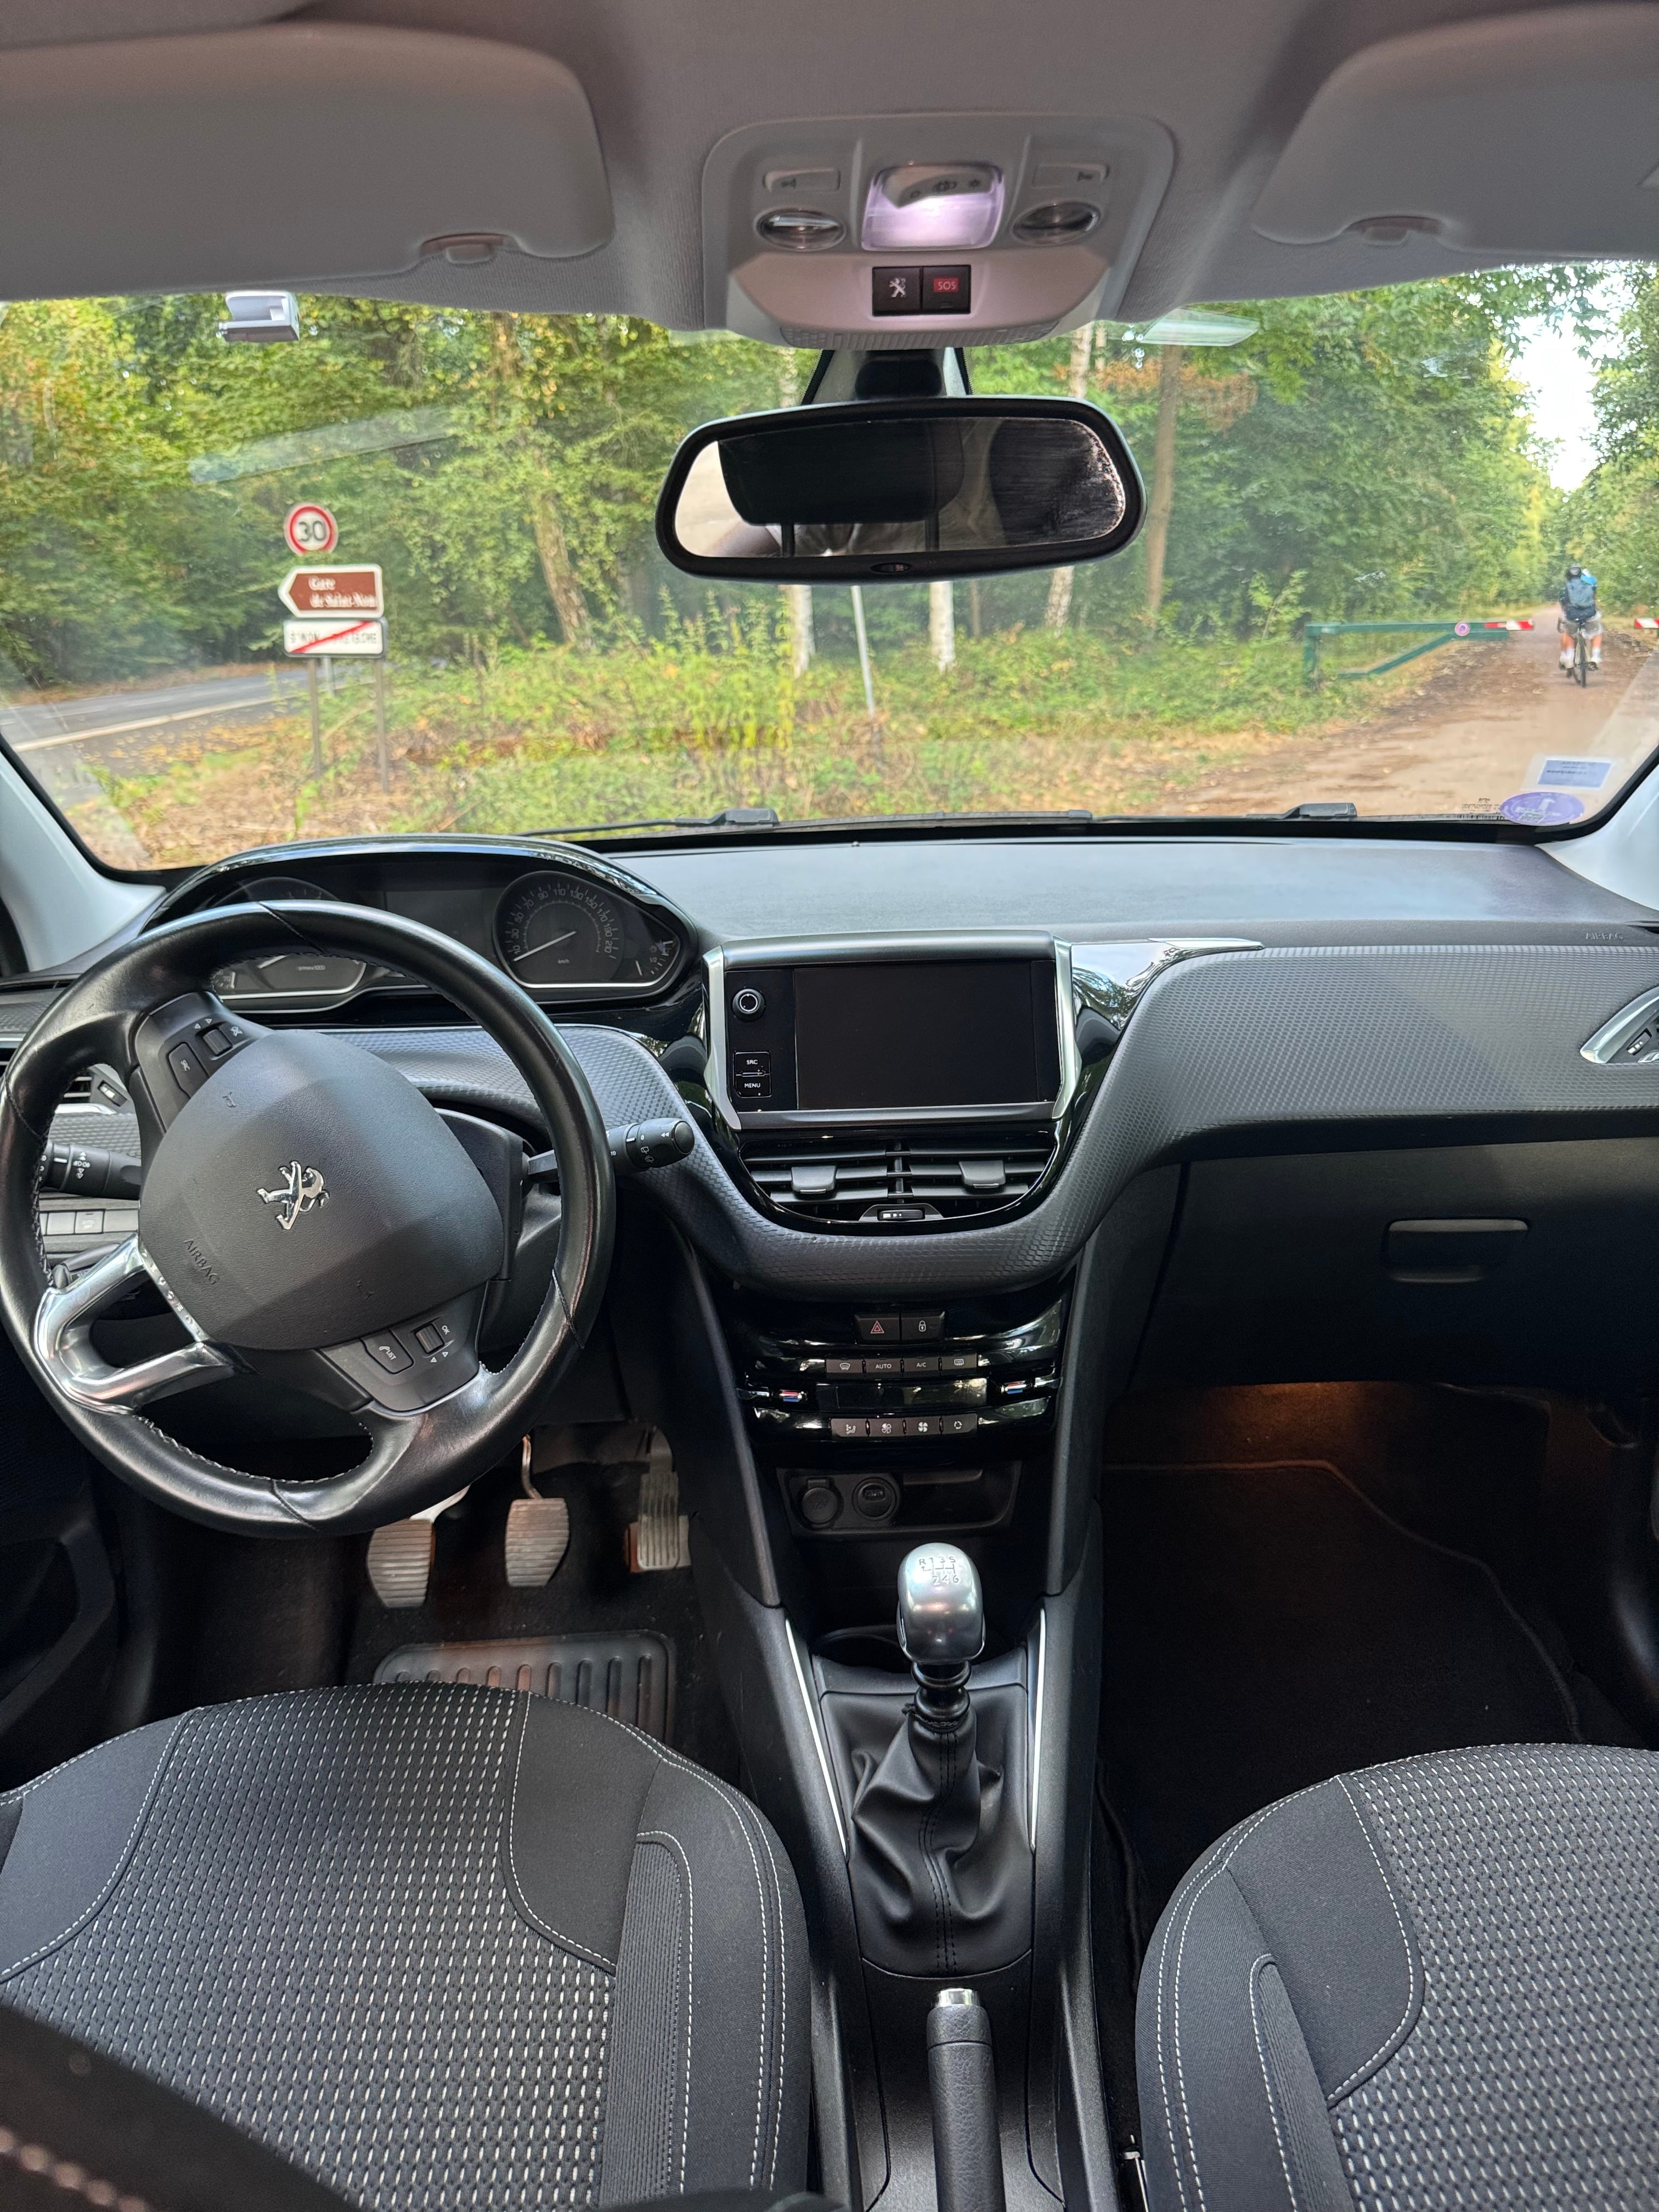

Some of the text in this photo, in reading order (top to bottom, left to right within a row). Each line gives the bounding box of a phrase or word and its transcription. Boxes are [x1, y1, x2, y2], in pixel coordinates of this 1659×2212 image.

[938, 281, 956, 290] SOS
[298, 521, 327, 541] 30
[308, 575, 336, 590] Gare
[538, 891, 549, 900] 90
[570, 890, 584, 900] 130
[524, 900, 534, 909] 70
[585, 897, 598, 909] 150
[515, 912, 524, 922] 50
[597, 909, 608, 922] 170
[511, 929, 520, 939] 30
[604, 923, 613, 937] 190
[513, 945, 521, 954] 10
[604, 940, 613, 953] 210
[180, 1059, 190, 1071] SRC
[183, 1239, 220, 1285] AIRBAG
[441, 1325, 450, 1335] OK
[386, 1350, 397, 1361] LIST
[932, 1575, 960, 1585] 2 4 6
